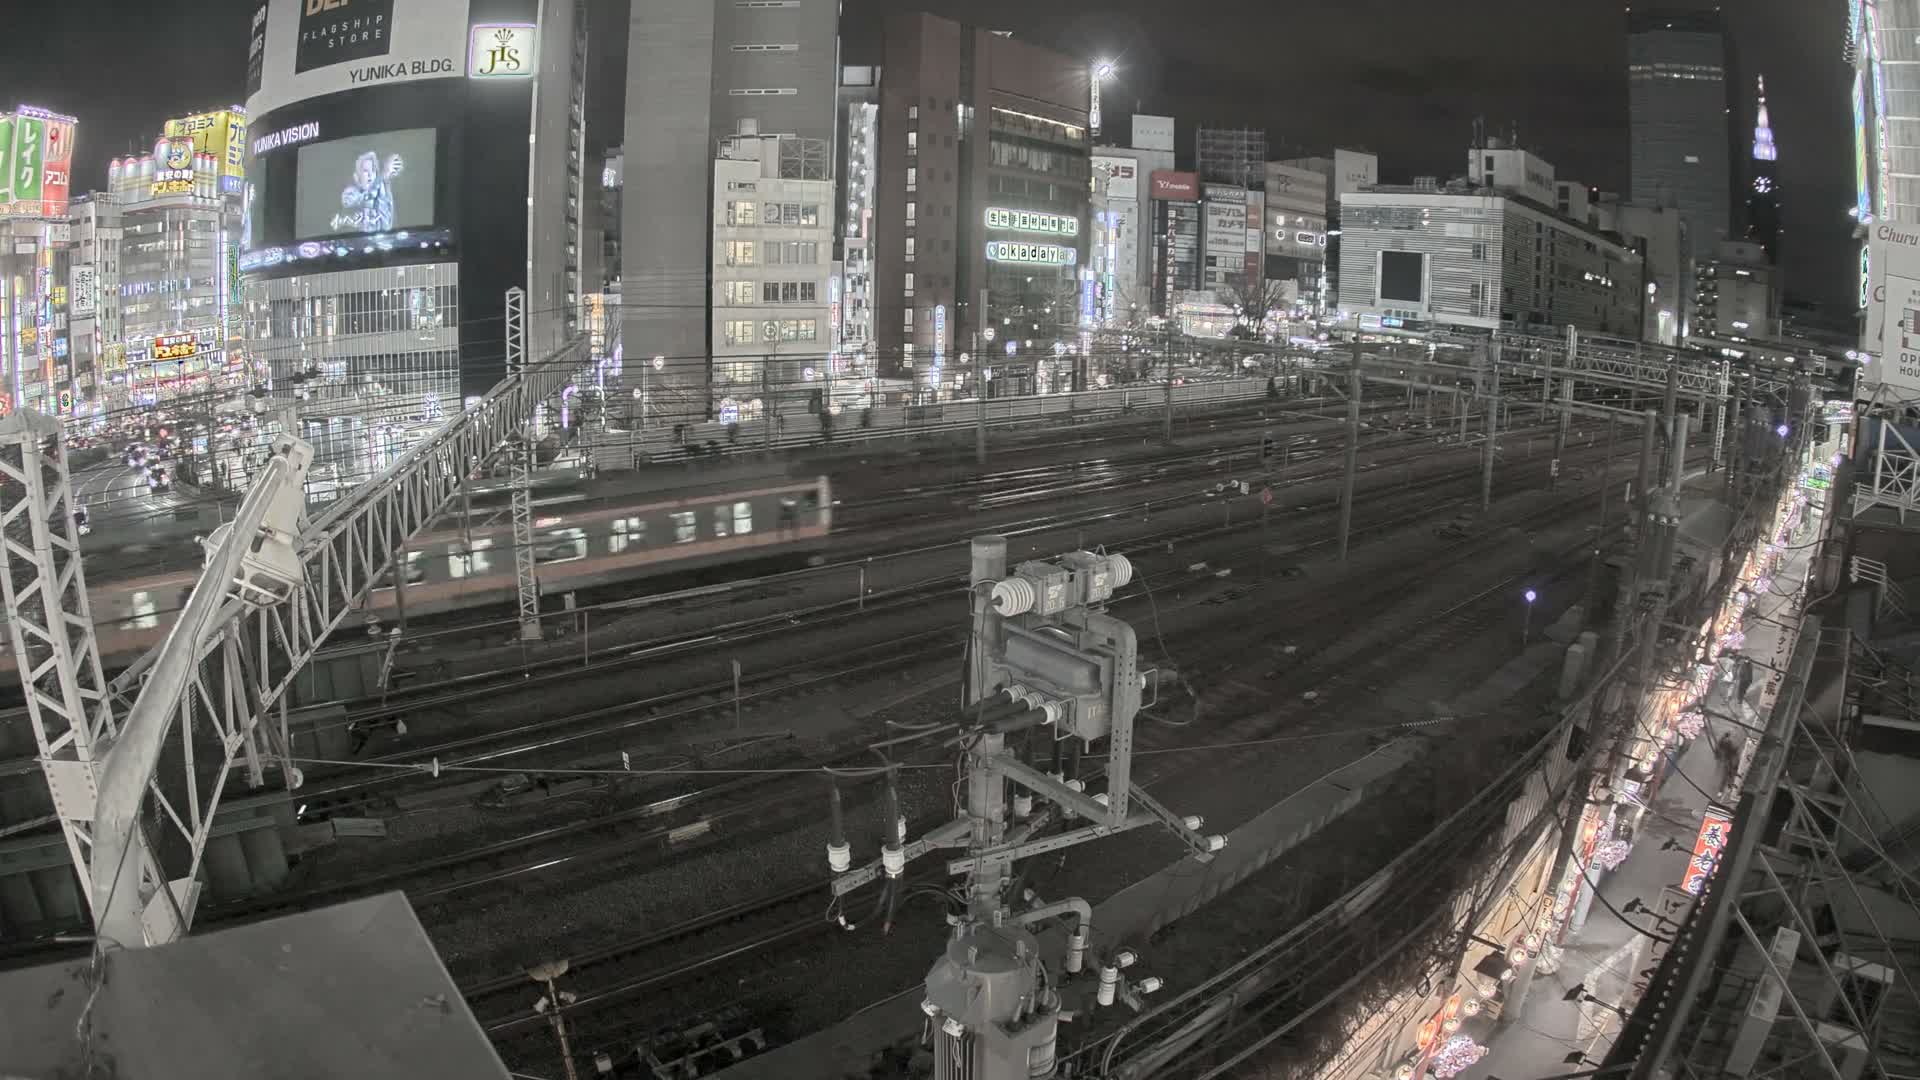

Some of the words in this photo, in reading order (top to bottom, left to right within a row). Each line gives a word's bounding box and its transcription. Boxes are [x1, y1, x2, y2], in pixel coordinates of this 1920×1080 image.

[303, 15, 383, 41] FLAGSHIP
[328, 29, 382, 48] STORE
[350, 62, 408, 83] YUNIKA
[411, 58, 455, 76] BLDG.
[253, 131, 281, 155] YUNIKA
[281, 121, 319, 145] VISION
[21, 121, 37, 189] レイク
[45, 170, 69, 186] アコム
[1000, 245, 1066, 261] okadaya
